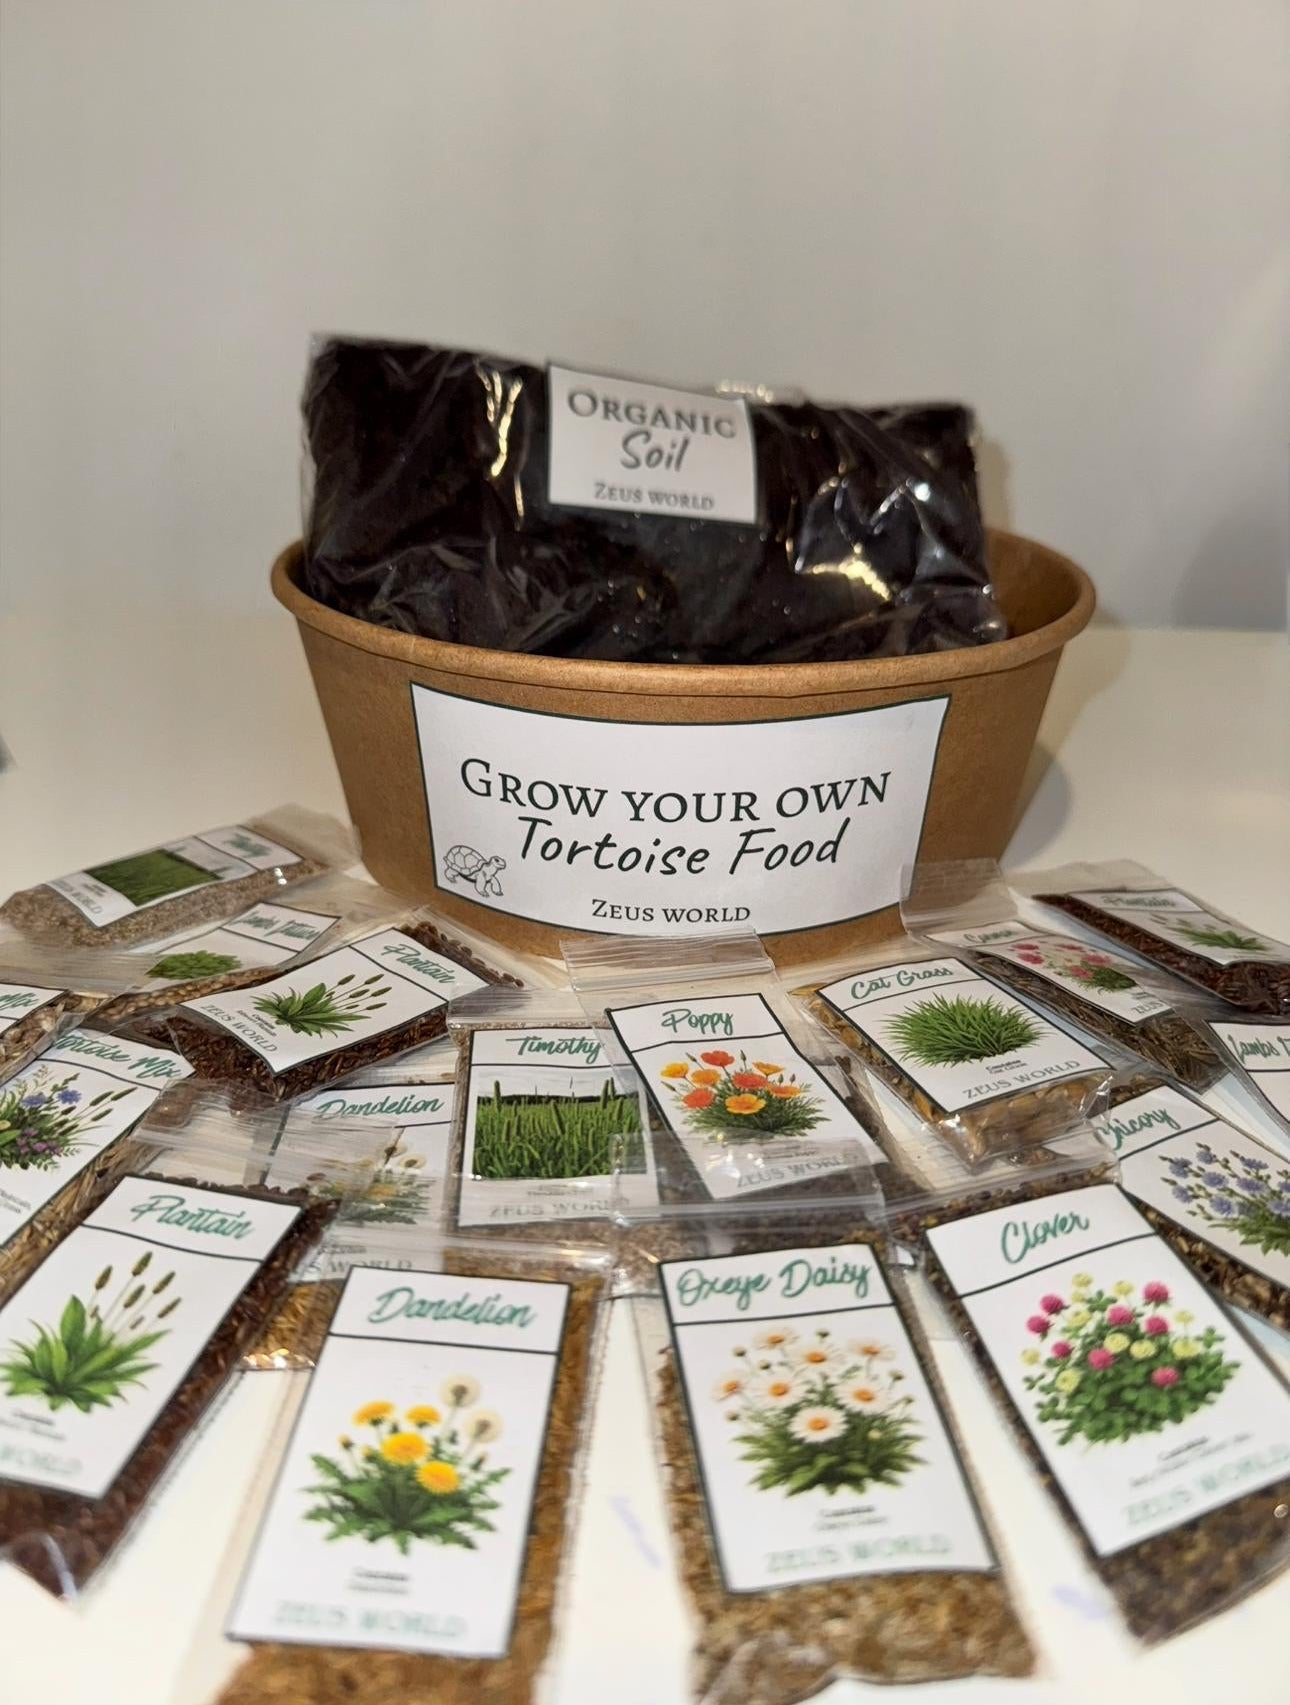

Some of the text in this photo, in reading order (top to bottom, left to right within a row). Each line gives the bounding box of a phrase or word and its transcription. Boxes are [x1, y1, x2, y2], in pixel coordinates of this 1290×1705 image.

[567, 390, 737, 439] ORGANIC
[620, 429, 690, 472] Soil
[594, 482, 715, 510] ZEUS WORLD
[460, 758, 892, 823] GROW YOUR OWN
[517, 816, 851, 875] Tortoise Food
[592, 898, 752, 923] ZEUS WORLD
[381, 943, 456, 984] Plantain
[850, 969, 954, 1000] Cat Grass
[200, 1004, 236, 1022] ZEUS
[231, 1022, 278, 1052] WORLD
[660, 1007, 734, 1036] Poppy
[127, 1056, 183, 1080] Mix
[505, 1035, 604, 1064] Timothy
[1227, 1034, 1281, 1065] Lambs
[962, 1079, 1012, 1100] ZEUS
[1013, 1060, 1081, 1084] WORLD
[312, 1094, 445, 1121] Dandelion
[130, 1194, 254, 1241] Plantain
[1001, 1209, 1091, 1265] Clover
[676, 1256, 872, 1311] Oxeye Daisy
[368, 1285, 538, 1330] Dandelion
